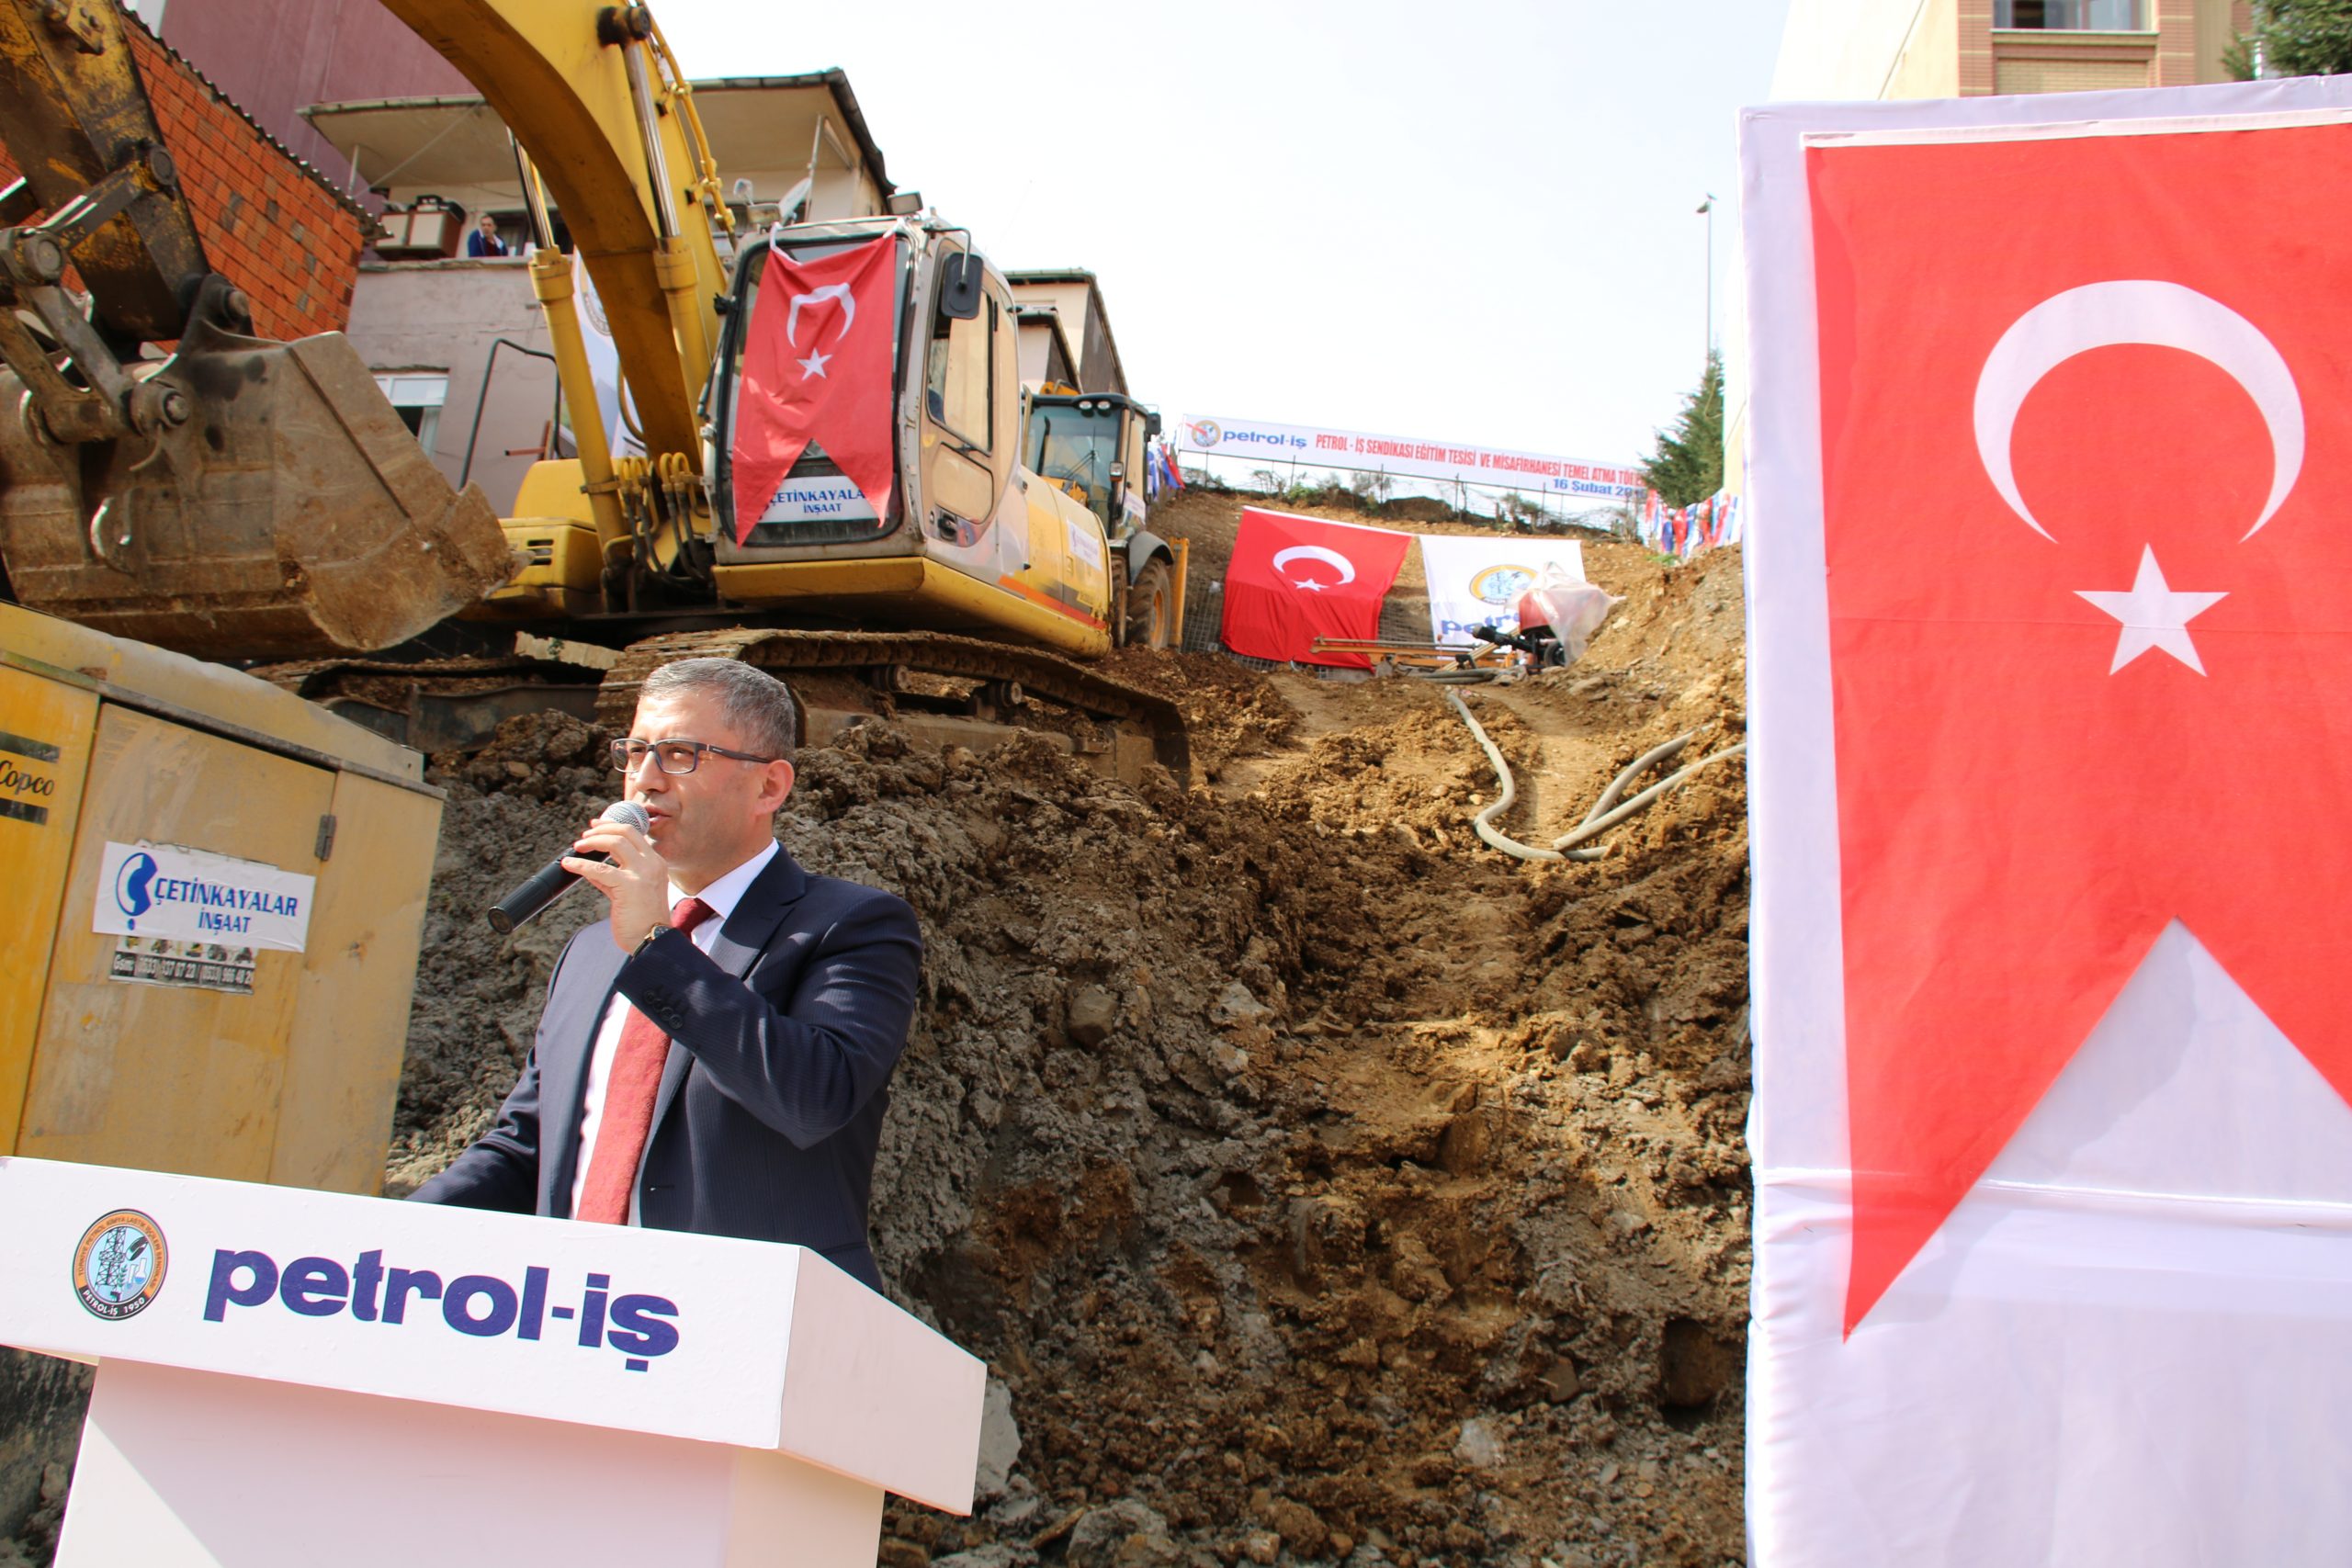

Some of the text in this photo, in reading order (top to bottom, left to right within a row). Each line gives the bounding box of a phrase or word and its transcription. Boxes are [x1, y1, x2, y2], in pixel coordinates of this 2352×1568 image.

[1223, 430, 1307, 449] petrol-iş
[1316, 434, 1348, 451] PETROL
[1355, 435, 1365, 456] İŞ
[1366, 439, 1414, 458] SENDİKASI
[1415, 443, 1446, 462] EĞİTİM
[1448, 447, 1476, 467] TESİSİ
[1480, 453, 1491, 468] VE
[1492, 452, 1561, 477] MİSAFİRHANESİ
[1564, 463, 1589, 479] TEMEL
[1591, 467, 1616, 483] ATMA
[770, 489, 865, 506] ÇETİNKAYALA
[1554, 478, 1567, 490] 16
[1572, 479, 1612, 495] Şubat
[803, 502, 842, 515] İNŞAAT
[0, 760, 55, 796] Copco
[153, 876, 298, 917] ÇETİNKAYALAR
[198, 908, 251, 935] İNŞAAT
[123, 1296, 145, 1314] 1950
[203, 1248, 680, 1372] petrol-iş
